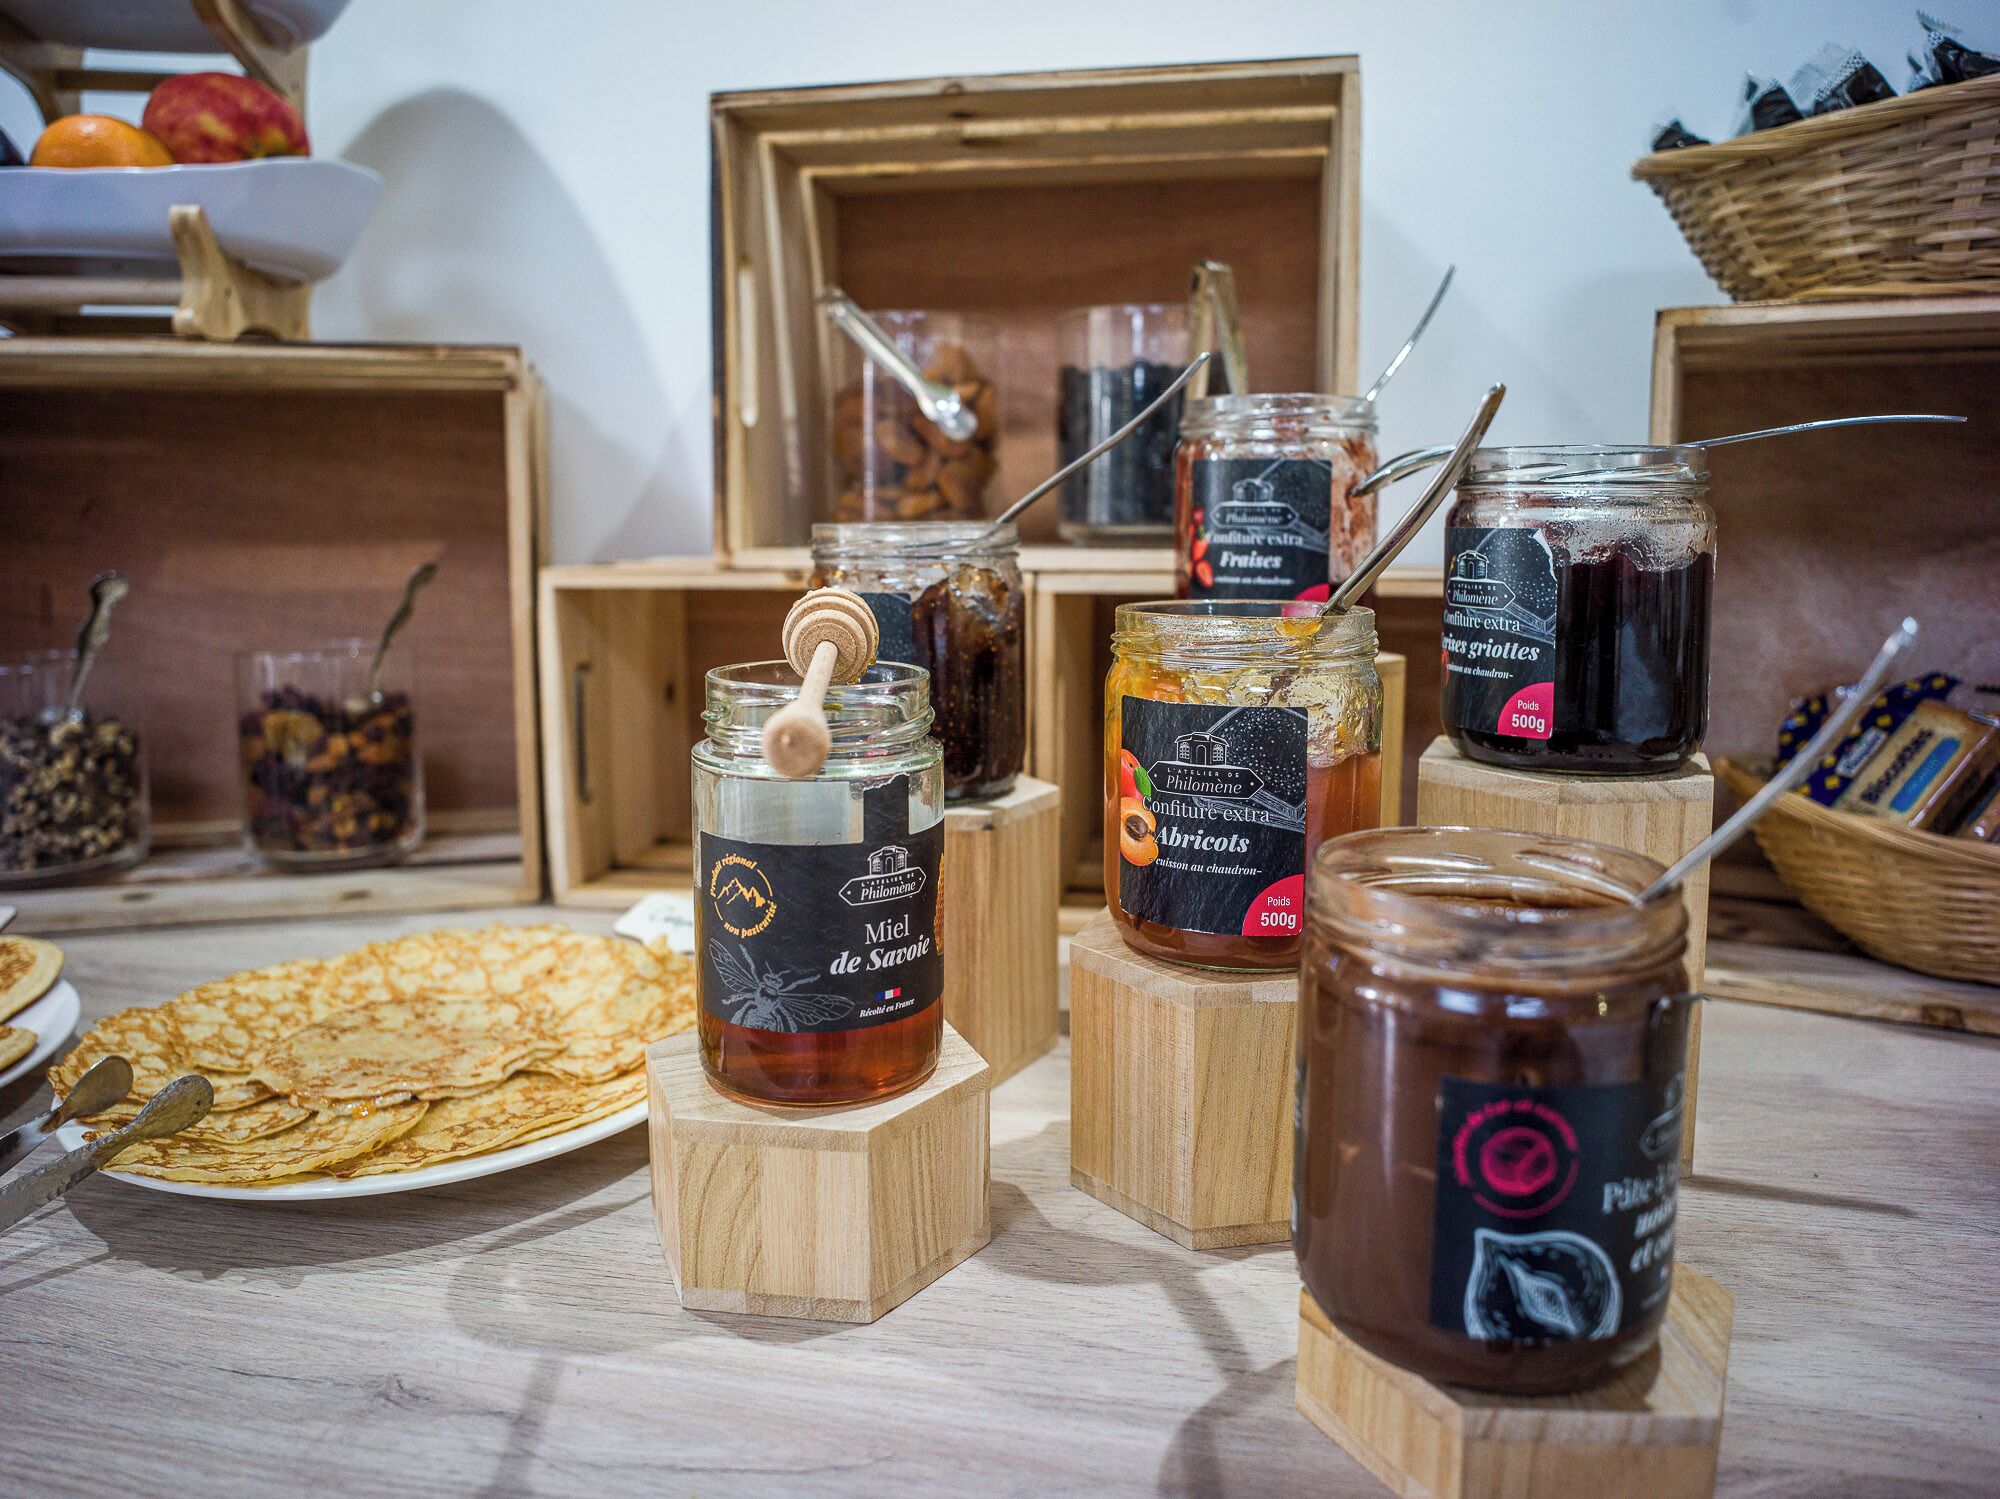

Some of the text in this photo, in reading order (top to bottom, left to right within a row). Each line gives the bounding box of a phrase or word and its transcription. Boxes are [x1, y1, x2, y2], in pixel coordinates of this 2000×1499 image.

[1219, 550, 1283, 569] Fraises
[1452, 589, 1498, 605] Philomène
[1484, 617, 1521, 632] extra
[1468, 638, 1540, 661] griottes
[1517, 699, 1540, 712] Poids
[1511, 713, 1546, 733] 500g
[1167, 767, 1219, 777] L'ATELIER
[1166, 775, 1242, 795] Philomène
[1142, 795, 1270, 822] Confiture extra
[1154, 826, 1250, 853] Abricots
[1190, 863, 1204, 872] au
[860, 881, 916, 901] Philomène
[1267, 896, 1291, 907] Poids
[865, 914, 910, 945] Miel
[1260, 912, 1297, 929] 500g
[829, 934, 930, 975] de Savoie
[886, 1002, 895, 1013] en
[895, 998, 915, 1011] France
